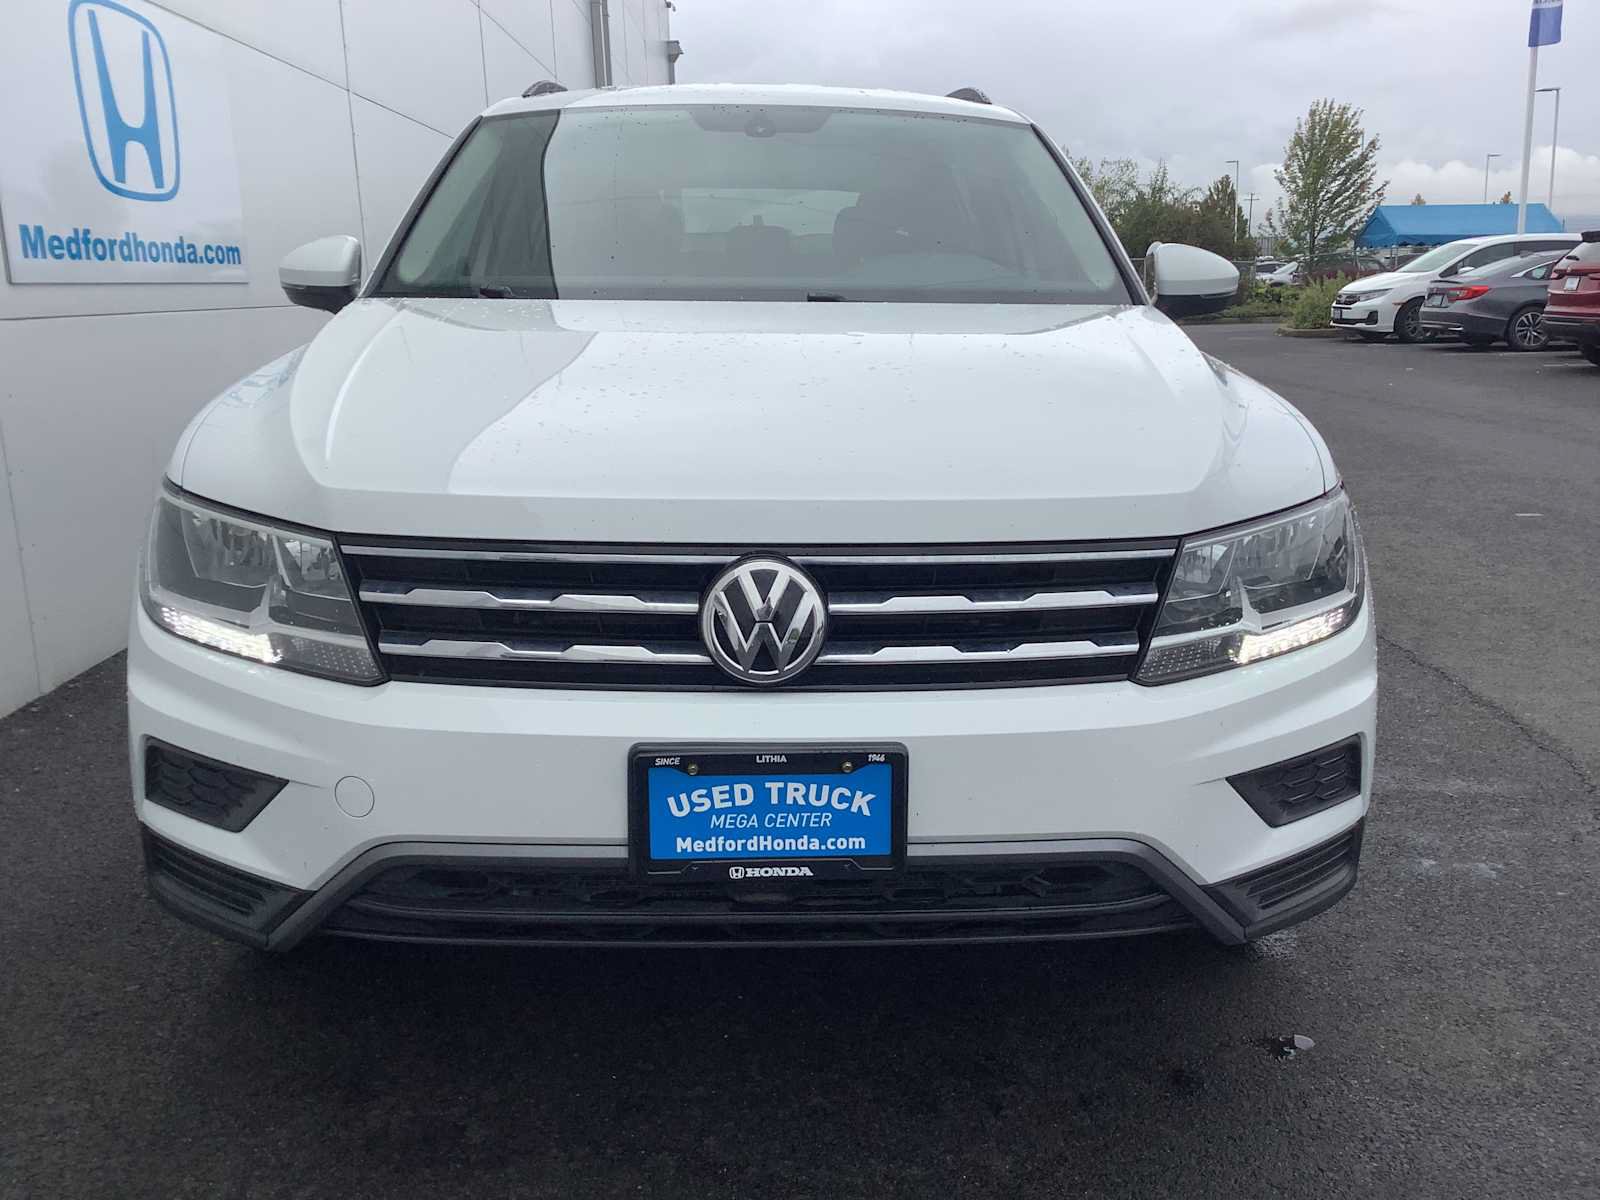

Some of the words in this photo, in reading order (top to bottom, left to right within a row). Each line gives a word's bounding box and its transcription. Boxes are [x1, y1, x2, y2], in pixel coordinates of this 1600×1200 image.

[18, 223, 242, 265] Medfordhonda.com
[655, 757, 680, 766] SINCE
[756, 755, 787, 763] LITHIA
[667, 783, 754, 817] USED
[764, 782, 876, 816] TRUCK
[710, 814, 758, 828] MEGA
[764, 813, 832, 827] CENTER
[676, 835, 866, 852] MedfordHonda.com
[745, 867, 813, 877] HONDA
